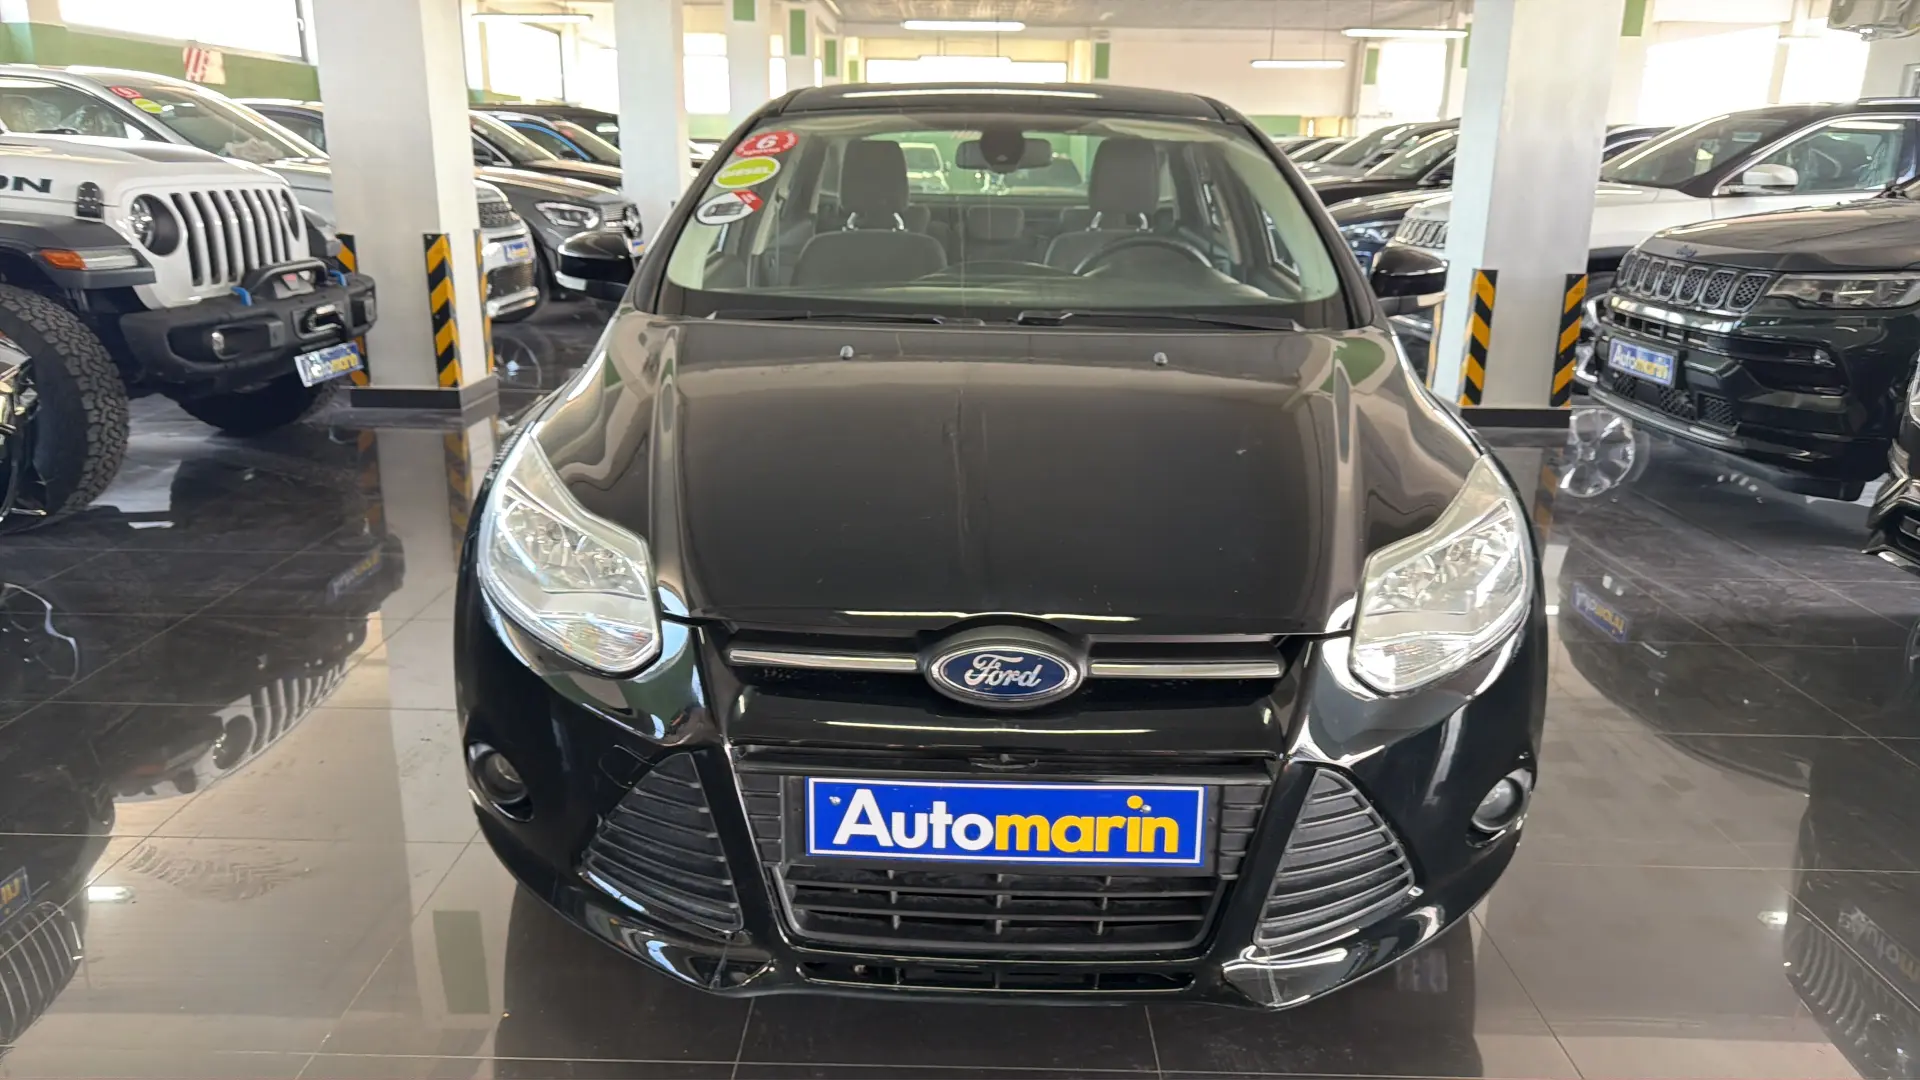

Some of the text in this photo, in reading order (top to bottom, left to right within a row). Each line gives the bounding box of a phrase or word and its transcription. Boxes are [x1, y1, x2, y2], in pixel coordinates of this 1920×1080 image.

[756, 134, 779, 149] 6
[963, 653, 1043, 688] Ford
[832, 788, 1179, 853] Automarin
